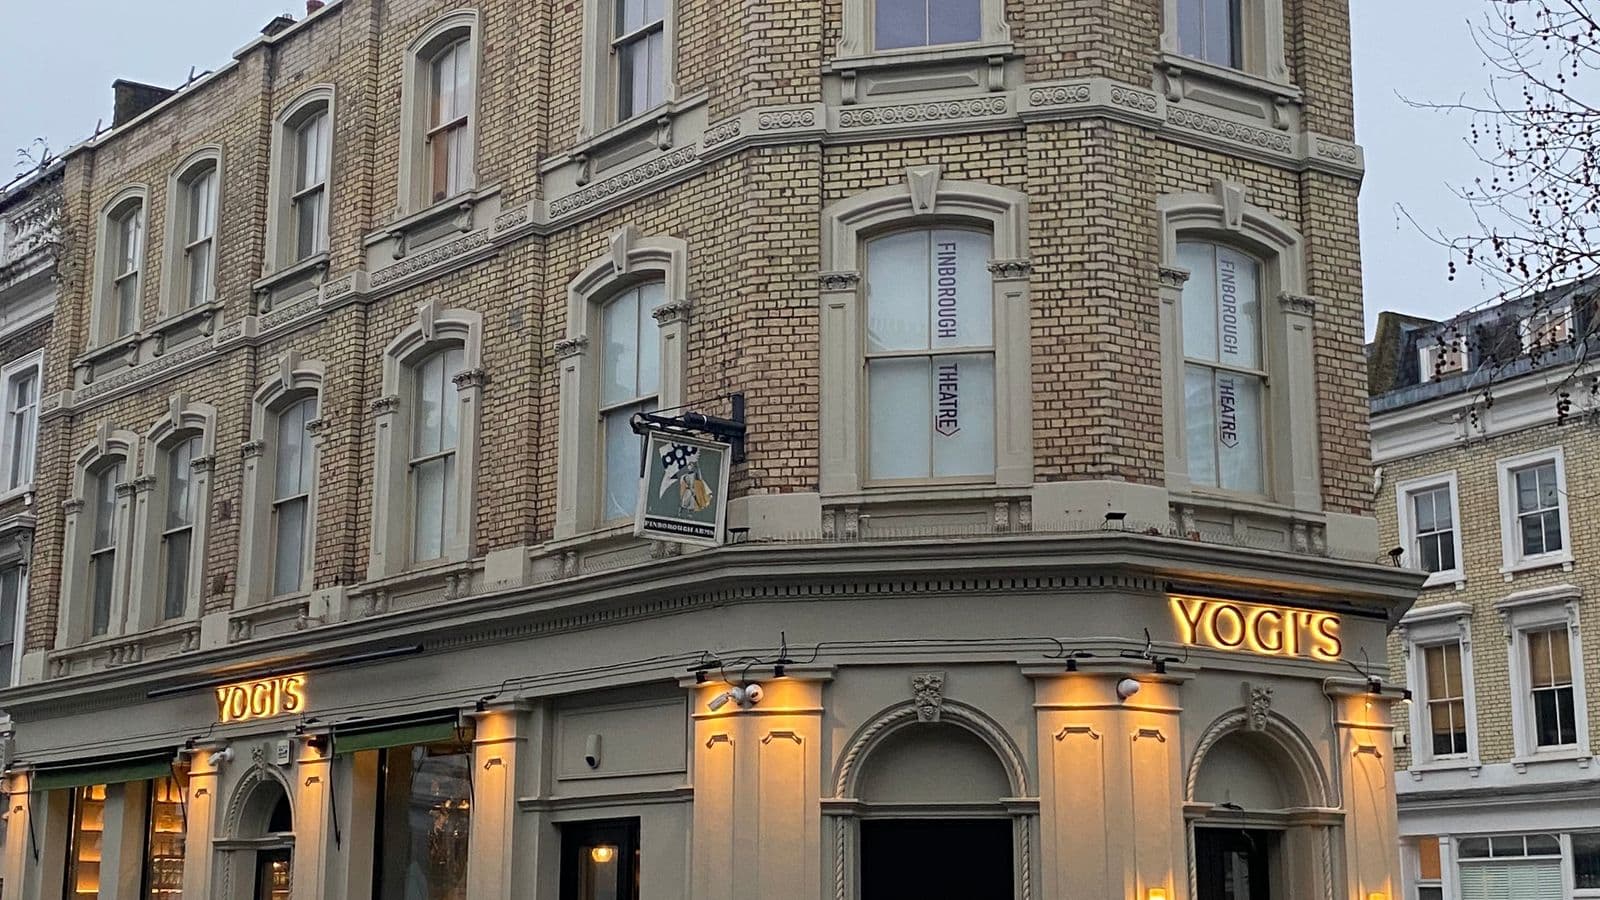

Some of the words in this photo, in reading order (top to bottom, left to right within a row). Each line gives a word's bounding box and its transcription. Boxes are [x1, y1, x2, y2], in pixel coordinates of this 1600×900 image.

[937, 242, 957, 338] FINBOROUGH
[1220, 259, 1238, 355] FINBOROUGH
[938, 362, 958, 428] THEATRE
[1219, 378, 1237, 441] THEATRE
[644, 520, 693, 533] FINBOROUGH
[694, 527, 714, 536] ARMS
[1171, 598, 1343, 658] YOGI'S
[215, 677, 302, 721] YOGI'S
